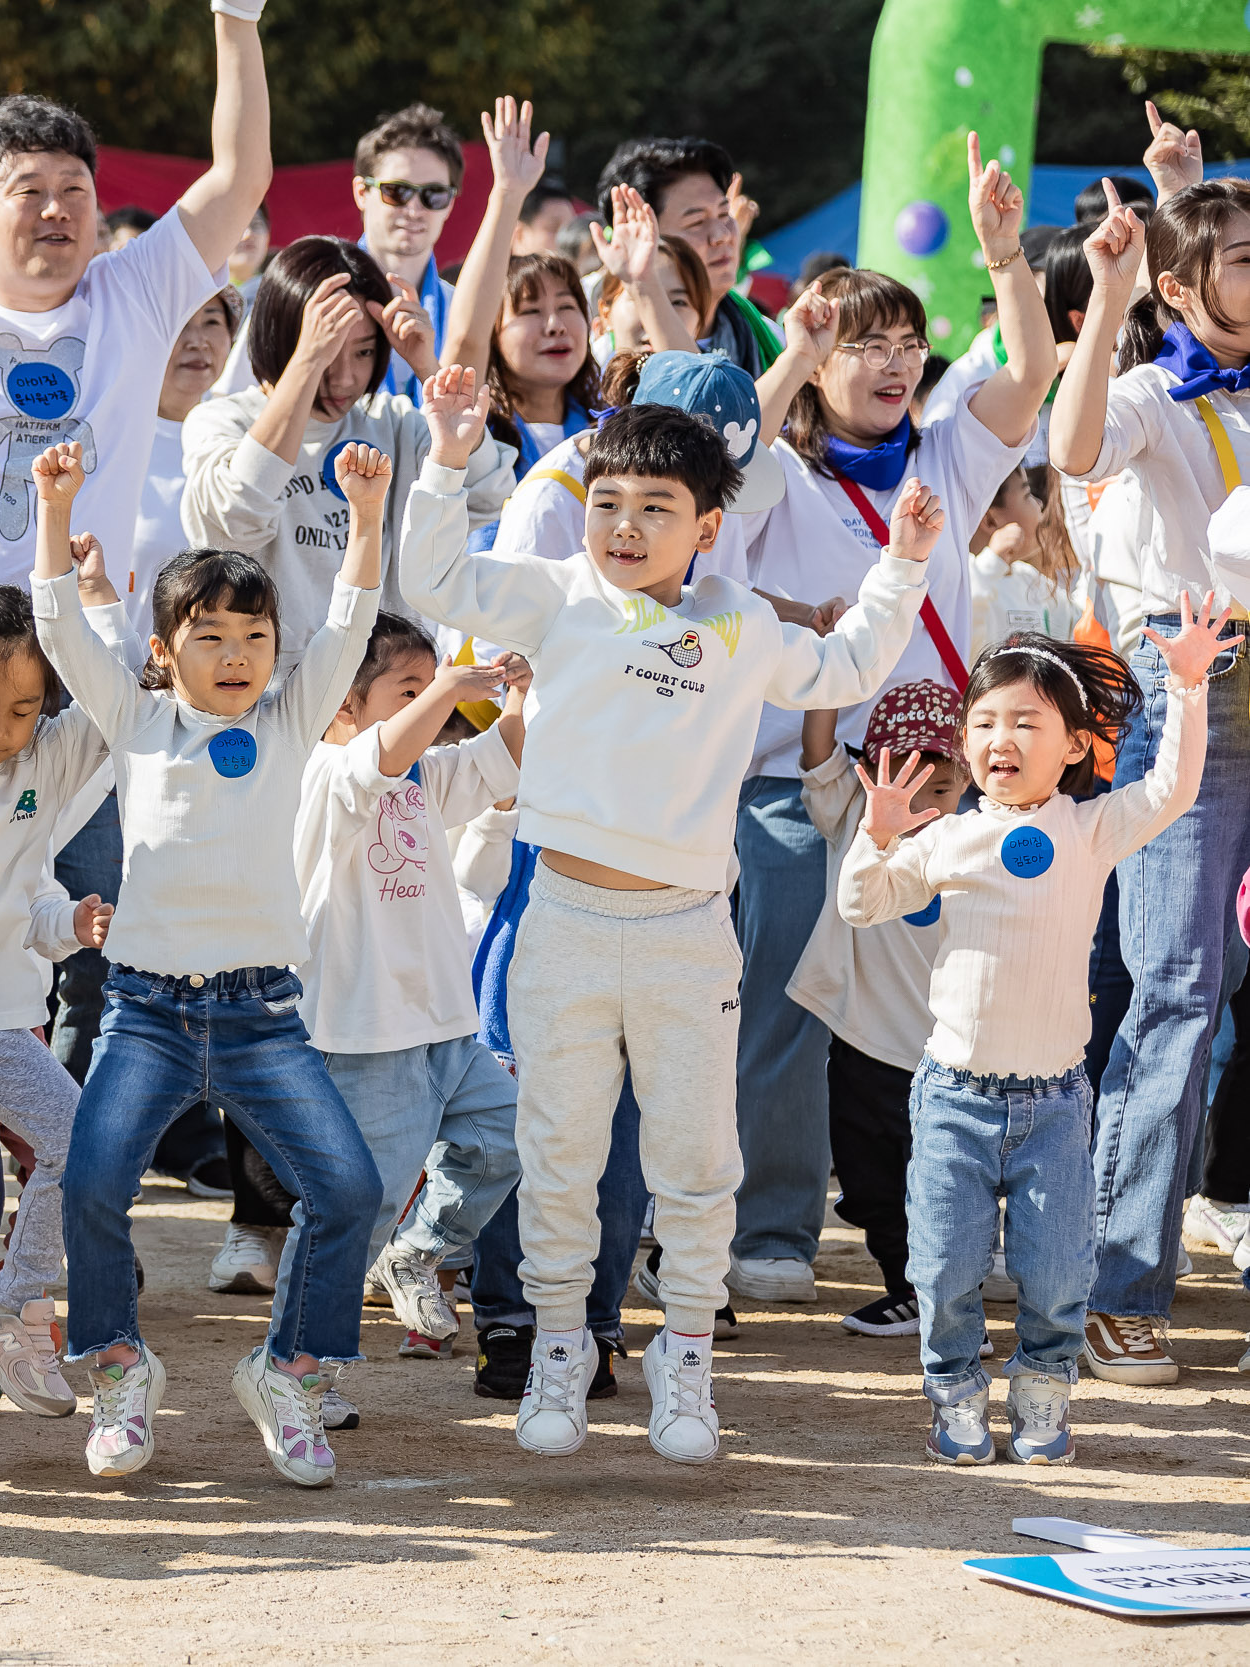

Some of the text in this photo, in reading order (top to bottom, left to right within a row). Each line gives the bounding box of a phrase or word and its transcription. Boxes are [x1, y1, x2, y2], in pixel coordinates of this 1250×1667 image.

[624, 665, 705, 693] F COURT CULB
[1012, 854, 1044, 867] 김도아
